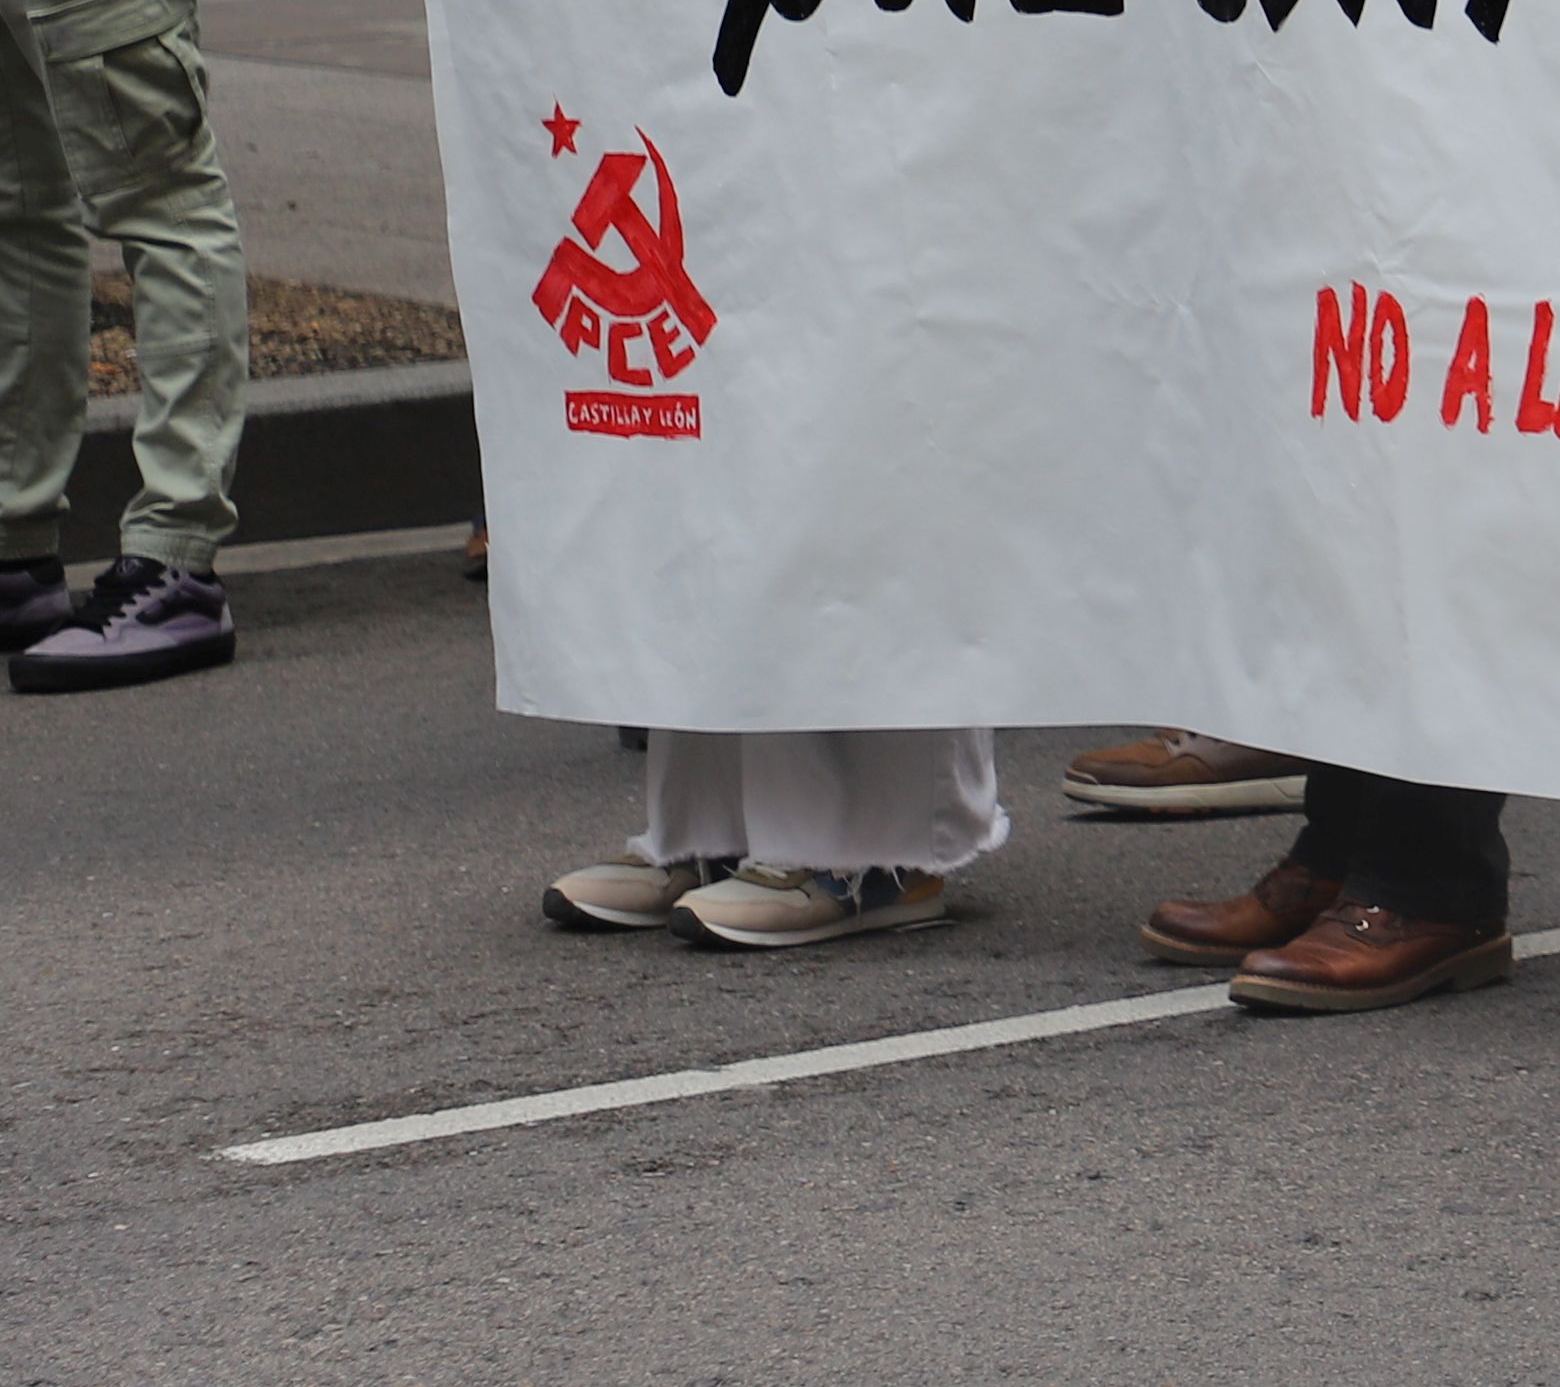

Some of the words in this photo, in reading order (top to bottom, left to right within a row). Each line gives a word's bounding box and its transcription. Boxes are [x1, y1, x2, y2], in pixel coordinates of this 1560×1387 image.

[562, 294, 696, 386] PCE
[1310, 281, 1411, 424] NO
[1440, 295, 1494, 434] A
